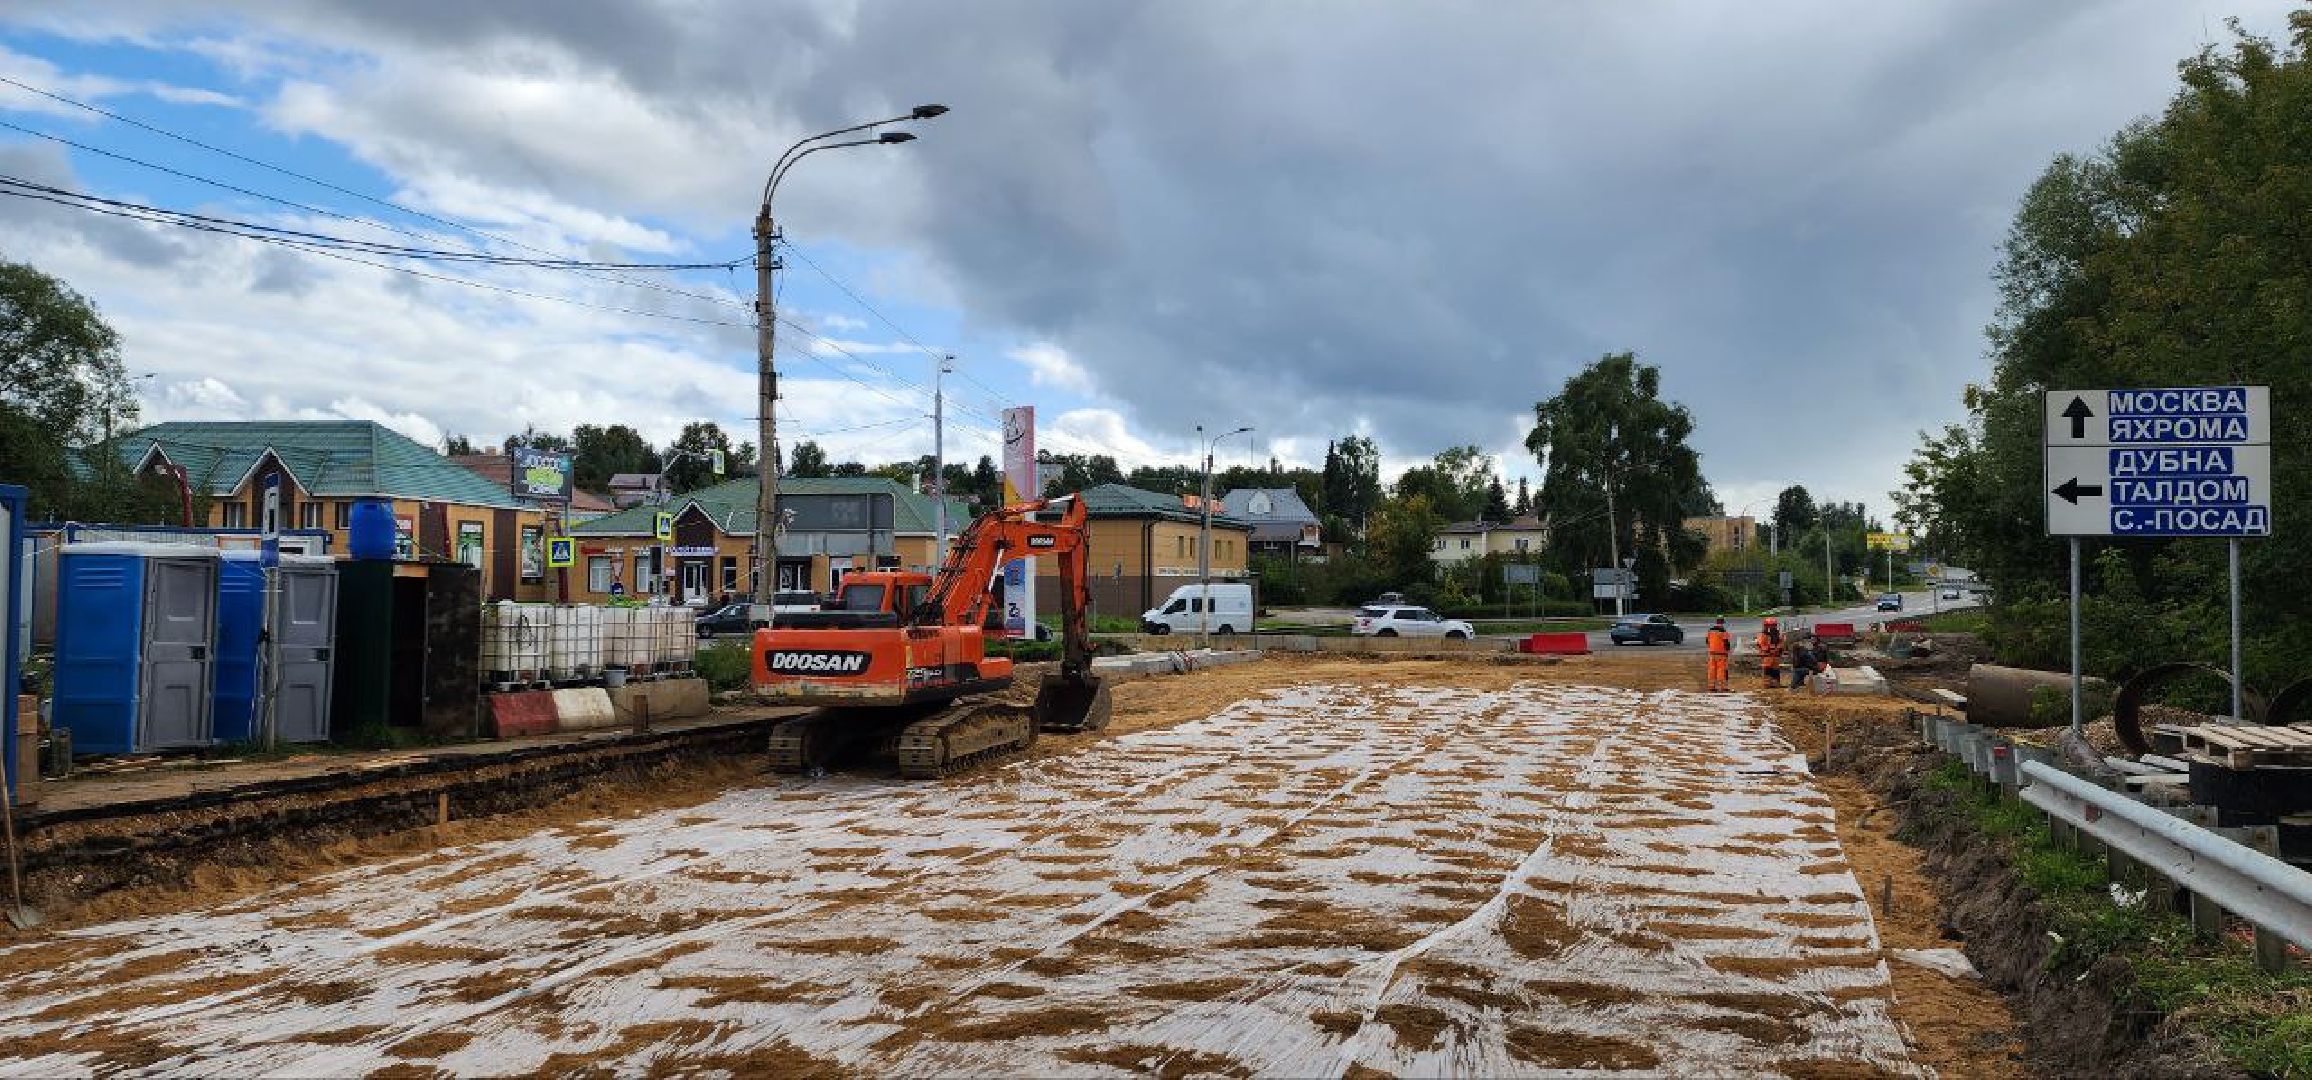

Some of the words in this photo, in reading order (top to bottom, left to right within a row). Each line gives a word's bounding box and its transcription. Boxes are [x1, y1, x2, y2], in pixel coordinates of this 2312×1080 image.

[2110, 391, 2245, 413] МОСКВА
[2112, 418, 2246, 439] ЯХРОМА
[2115, 450, 2227, 477] ДУБНА
[2114, 480, 2246, 504] ТАЛДОМ
[2114, 509, 2266, 534] С.-ПОСАД
[772, 653, 864, 670] DOOSAN
